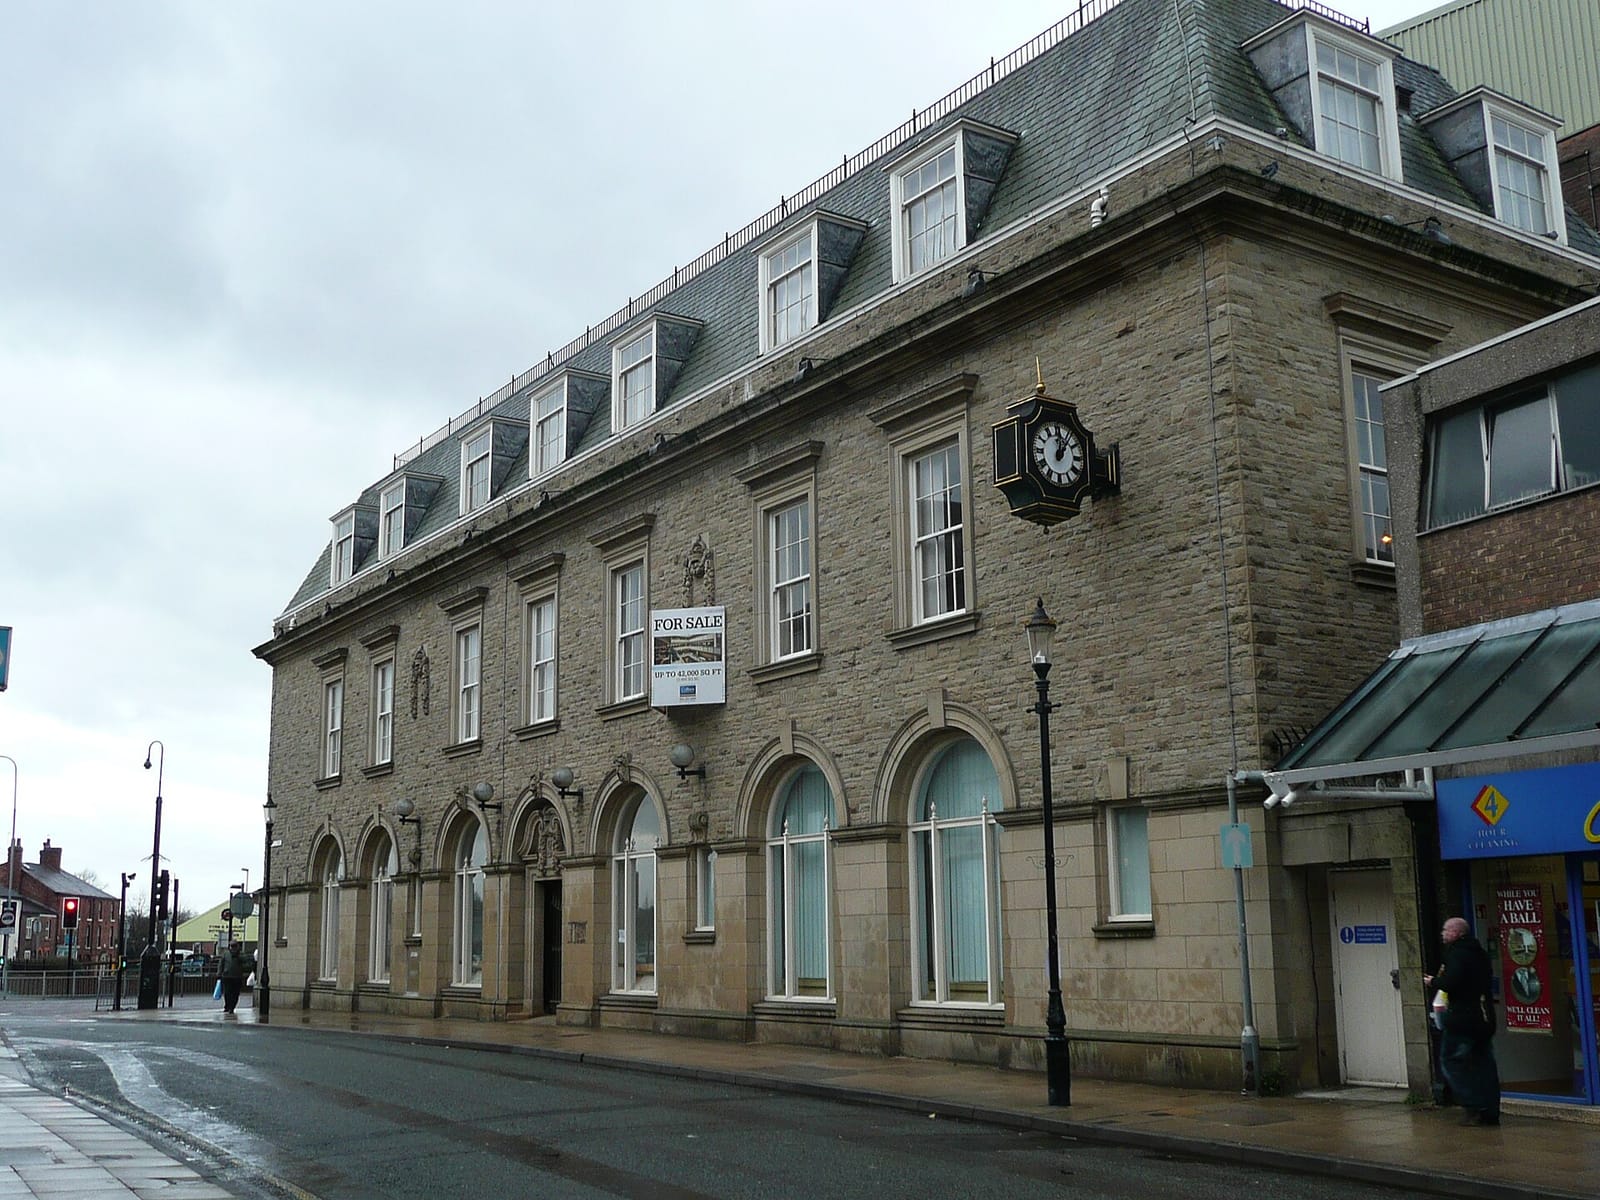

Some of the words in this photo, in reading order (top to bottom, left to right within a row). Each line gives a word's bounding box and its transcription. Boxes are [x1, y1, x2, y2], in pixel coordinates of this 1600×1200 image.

[654, 618, 682, 631] FOR
[686, 616, 722, 629] SALE
[1485, 791, 1498, 818] 4
[1496, 890, 1521, 898] WHILE
[1522, 889, 1537, 897] YOU
[1504, 899, 1534, 911] HAVE
[1500, 913, 1509, 924] A
[1510, 912, 1541, 924] BALL
[1526, 1006, 1550, 1014] CLEAN
[1517, 1014, 1524, 1022] IT
[1524, 1014, 1540, 1022] ALL!
